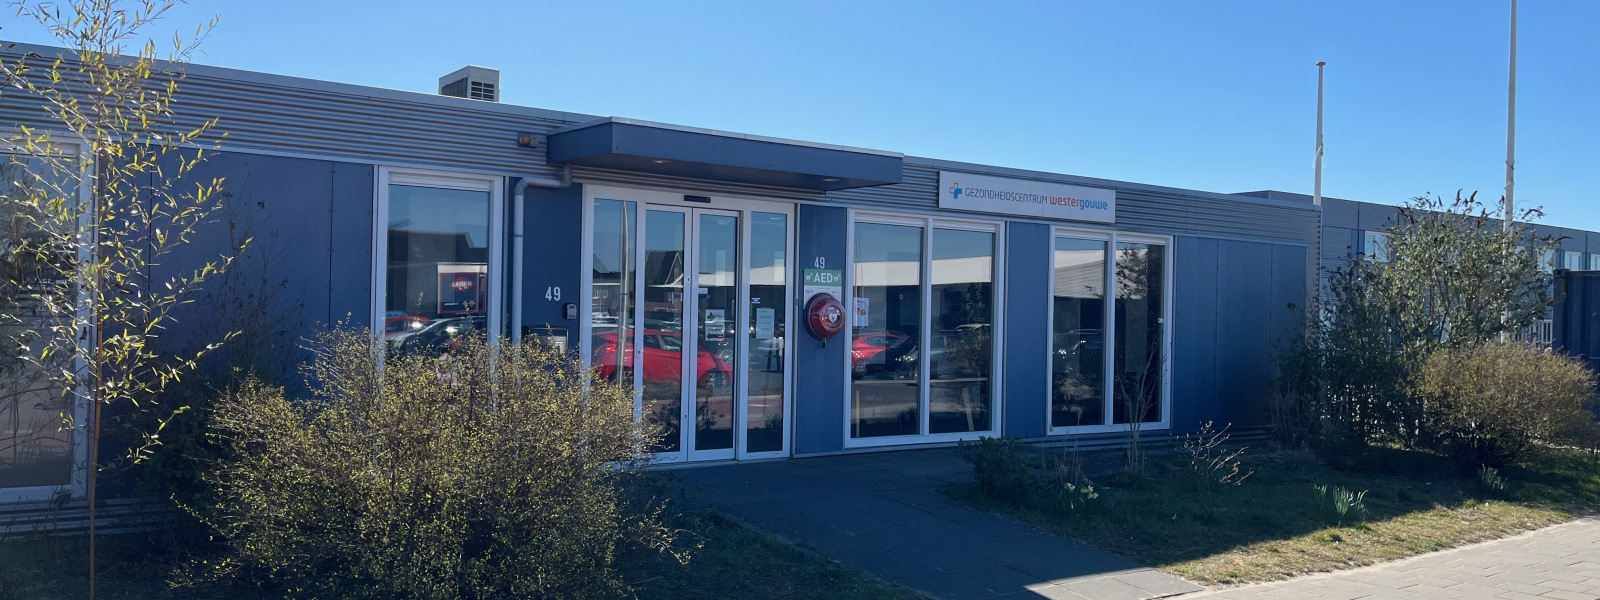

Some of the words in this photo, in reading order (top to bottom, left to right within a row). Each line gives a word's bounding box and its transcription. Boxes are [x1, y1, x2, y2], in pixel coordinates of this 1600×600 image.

[965, 187, 1048, 204] GEZONDHEIDSCENTRUM
[1049, 196, 1108, 211] westergouwe
[814, 256, 826, 269] 49
[813, 272, 833, 283] AED
[545, 286, 561, 301] 49
